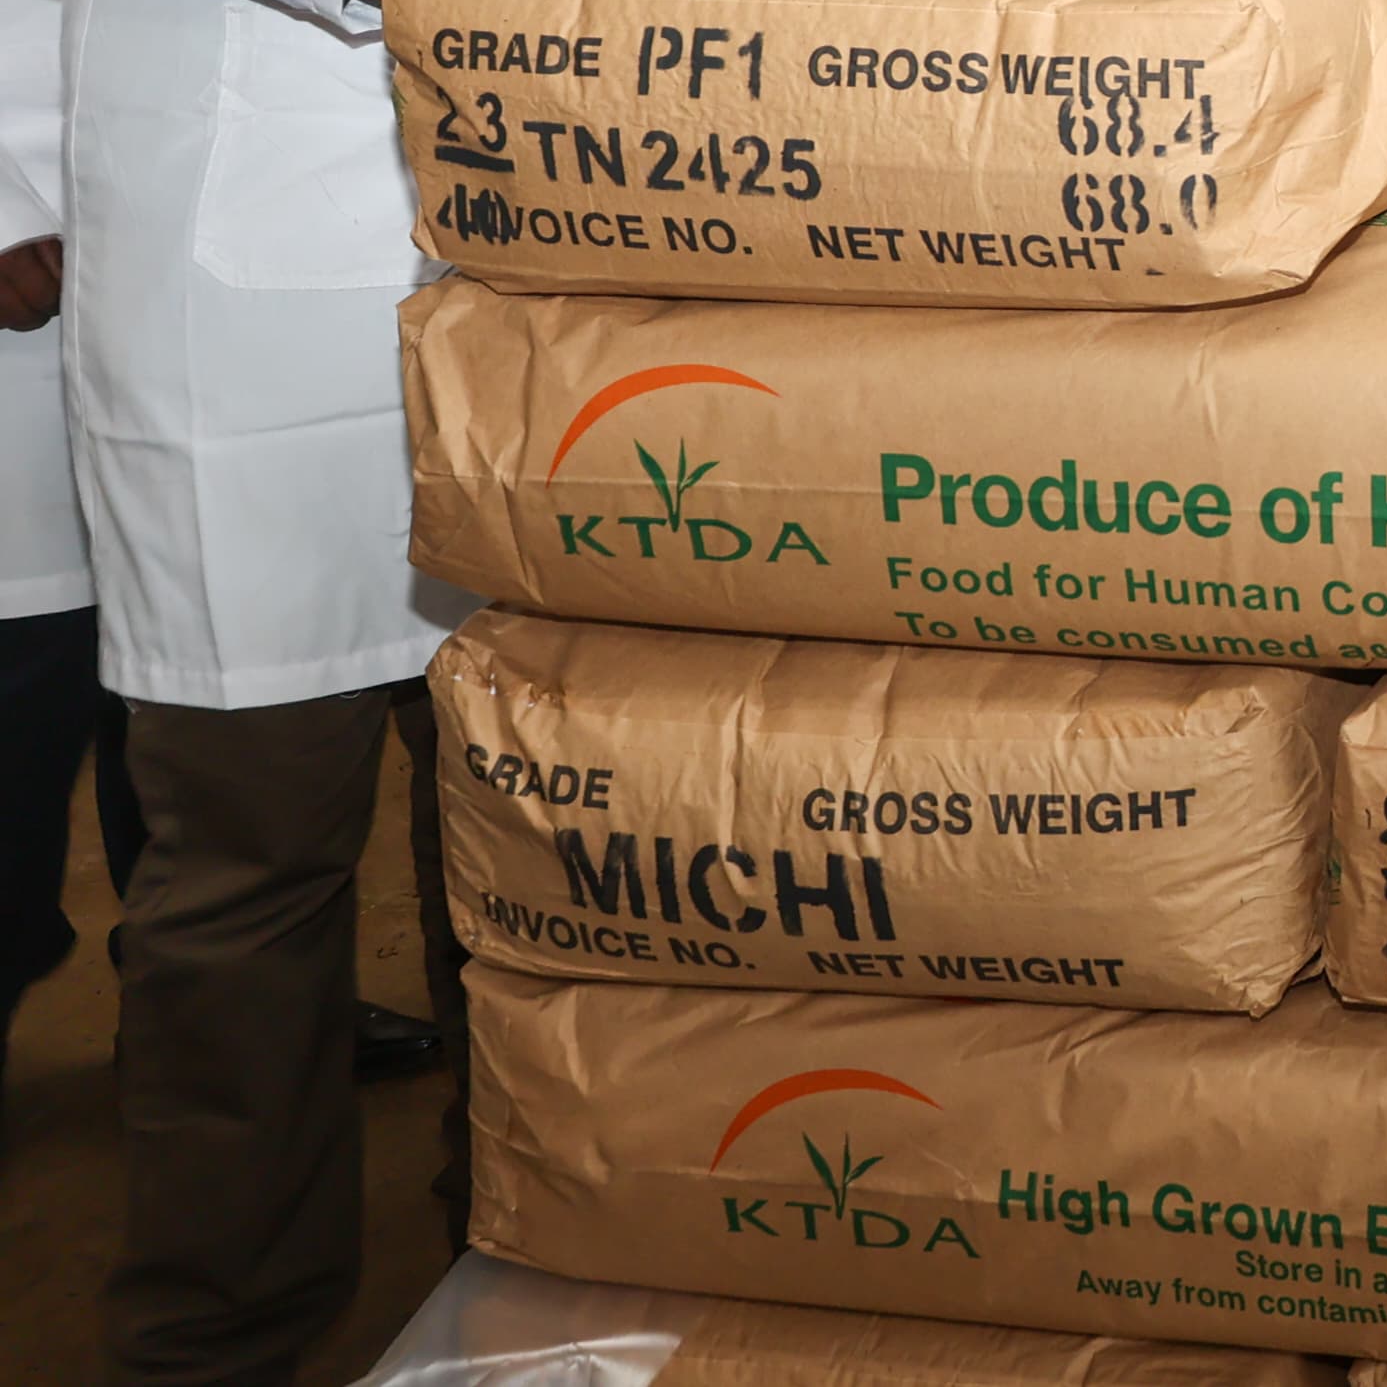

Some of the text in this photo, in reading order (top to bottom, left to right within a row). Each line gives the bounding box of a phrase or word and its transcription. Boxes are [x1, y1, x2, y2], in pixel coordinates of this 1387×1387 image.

[433, 26, 1205, 100] GRADE PF1 GROSS WEIGHT
[435, 86, 509, 152] 23
[1058, 94, 1219, 157] 68.4
[1062, 173, 1219, 234] 68.0
[664, 216, 753, 255] NO.
[807, 224, 1125, 272] NET WEIGHT
[880, 453, 1232, 538] Produce
[1260, 471, 1343, 544] of
[556, 514, 832, 566] KTDA
[887, 557, 1014, 597] Food
[1033, 564, 1105, 601] for
[1125, 568, 1300, 612] Human
[894, 611, 957, 639] To
[974, 616, 1037, 644] be
[1057, 627, 1320, 660] consumed
[465, 743, 1196, 835] GRADE GROSS WEIGHT
[554, 827, 896, 942] MICHI
[668, 936, 756, 970] NO.
[807, 950, 1124, 987] NET WEIGHT
[723, 1198, 982, 1260] KTDA
[999, 1169, 1130, 1235] High
[1152, 1183, 1344, 1250] Grown
[1076, 1269, 1161, 1305] Away
[1172, 1277, 1246, 1311] from
[1235, 1250, 1324, 1283] Store
[1335, 1259, 1361, 1289] in
